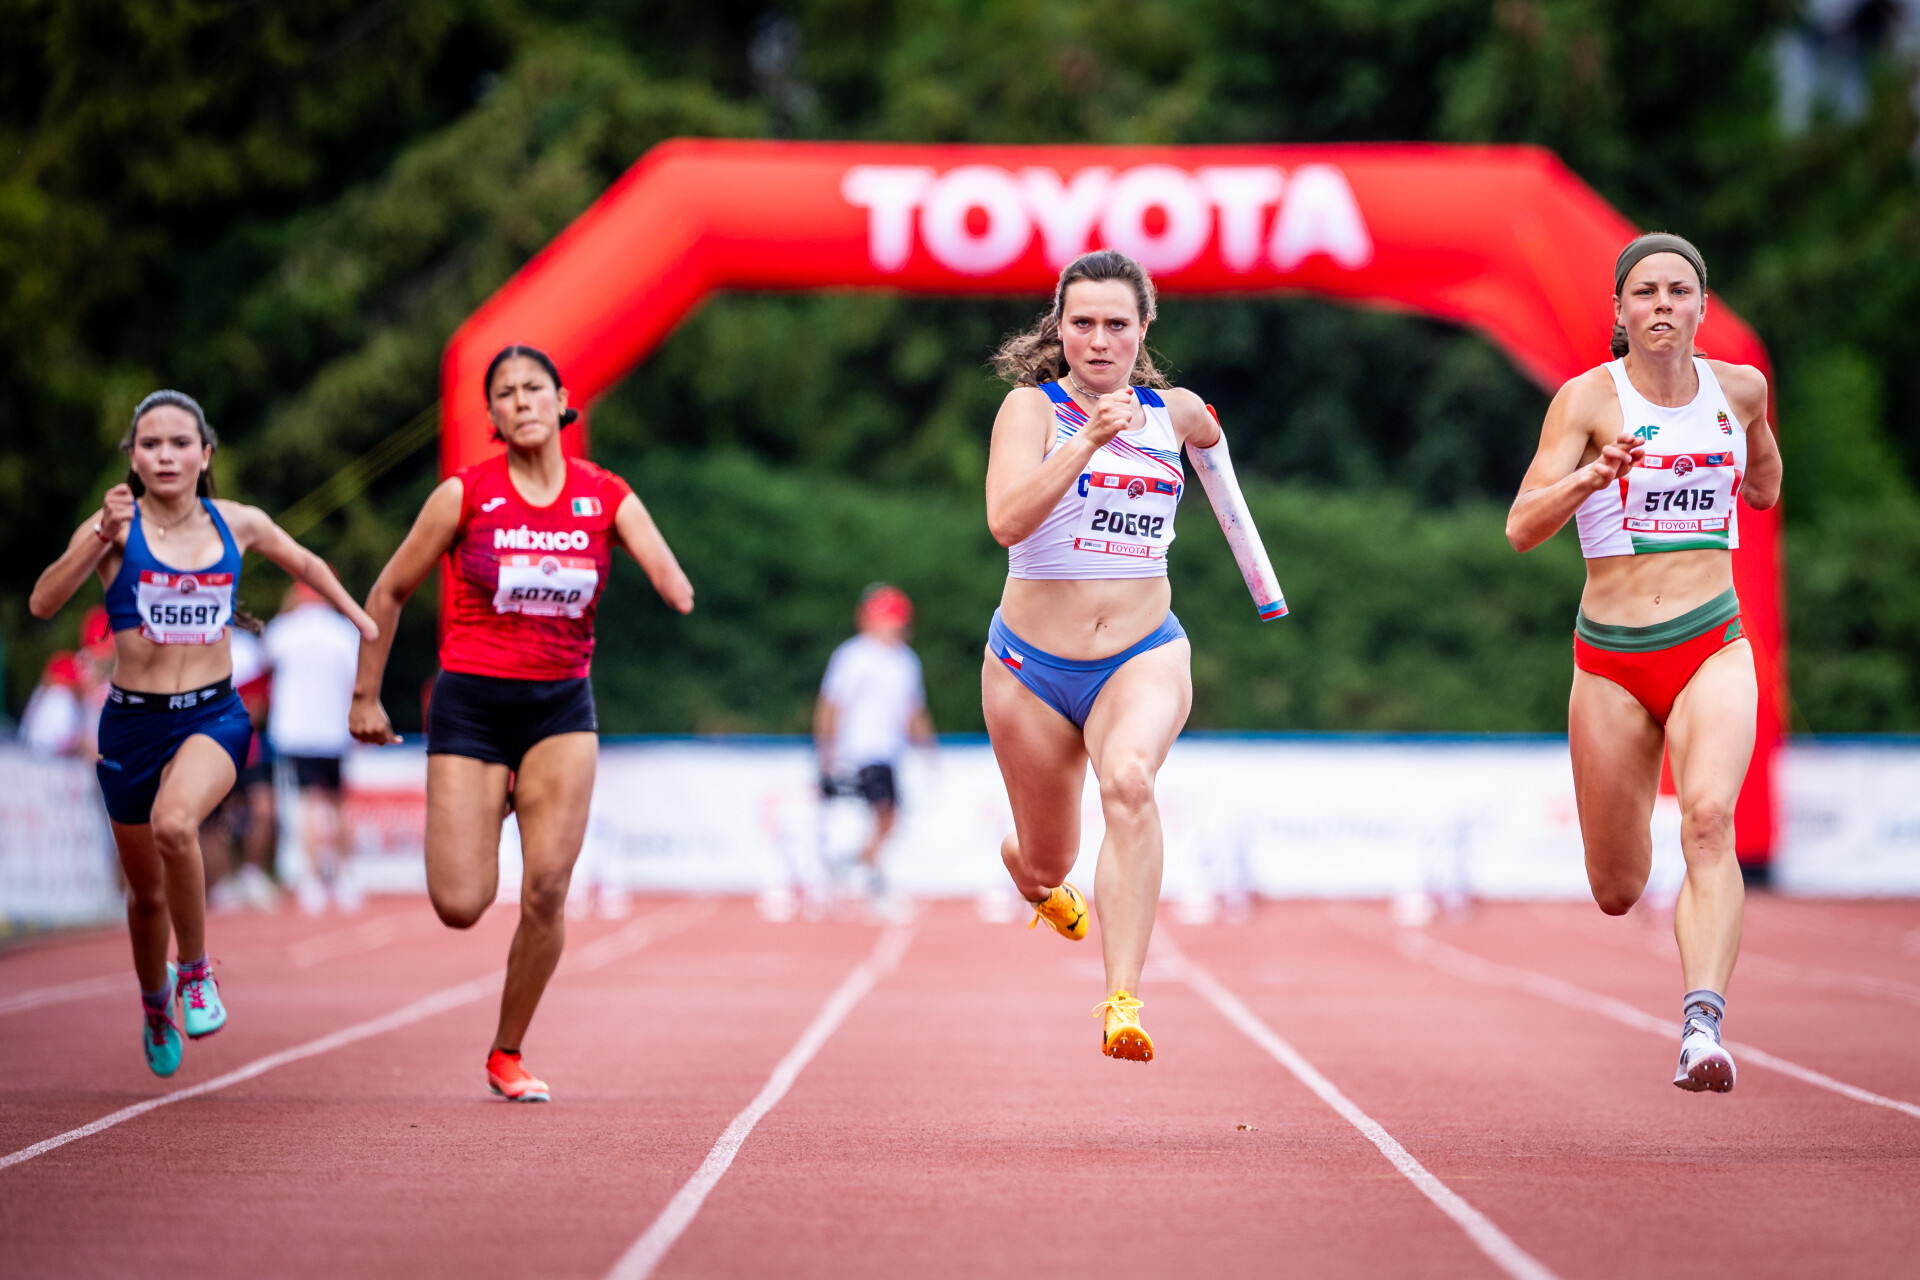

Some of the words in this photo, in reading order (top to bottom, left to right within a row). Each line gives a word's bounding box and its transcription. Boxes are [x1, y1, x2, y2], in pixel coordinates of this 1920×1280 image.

[842, 164, 1373, 274] TOYOTA
[1644, 488, 1716, 512] 57415
[1090, 508, 1165, 539] 20692
[1659, 521, 1697, 530] TOYOTA
[493, 524, 590, 551] MÉXICO
[1111, 544, 1146, 555] TOYOTA
[150, 604, 220, 625] 65697
